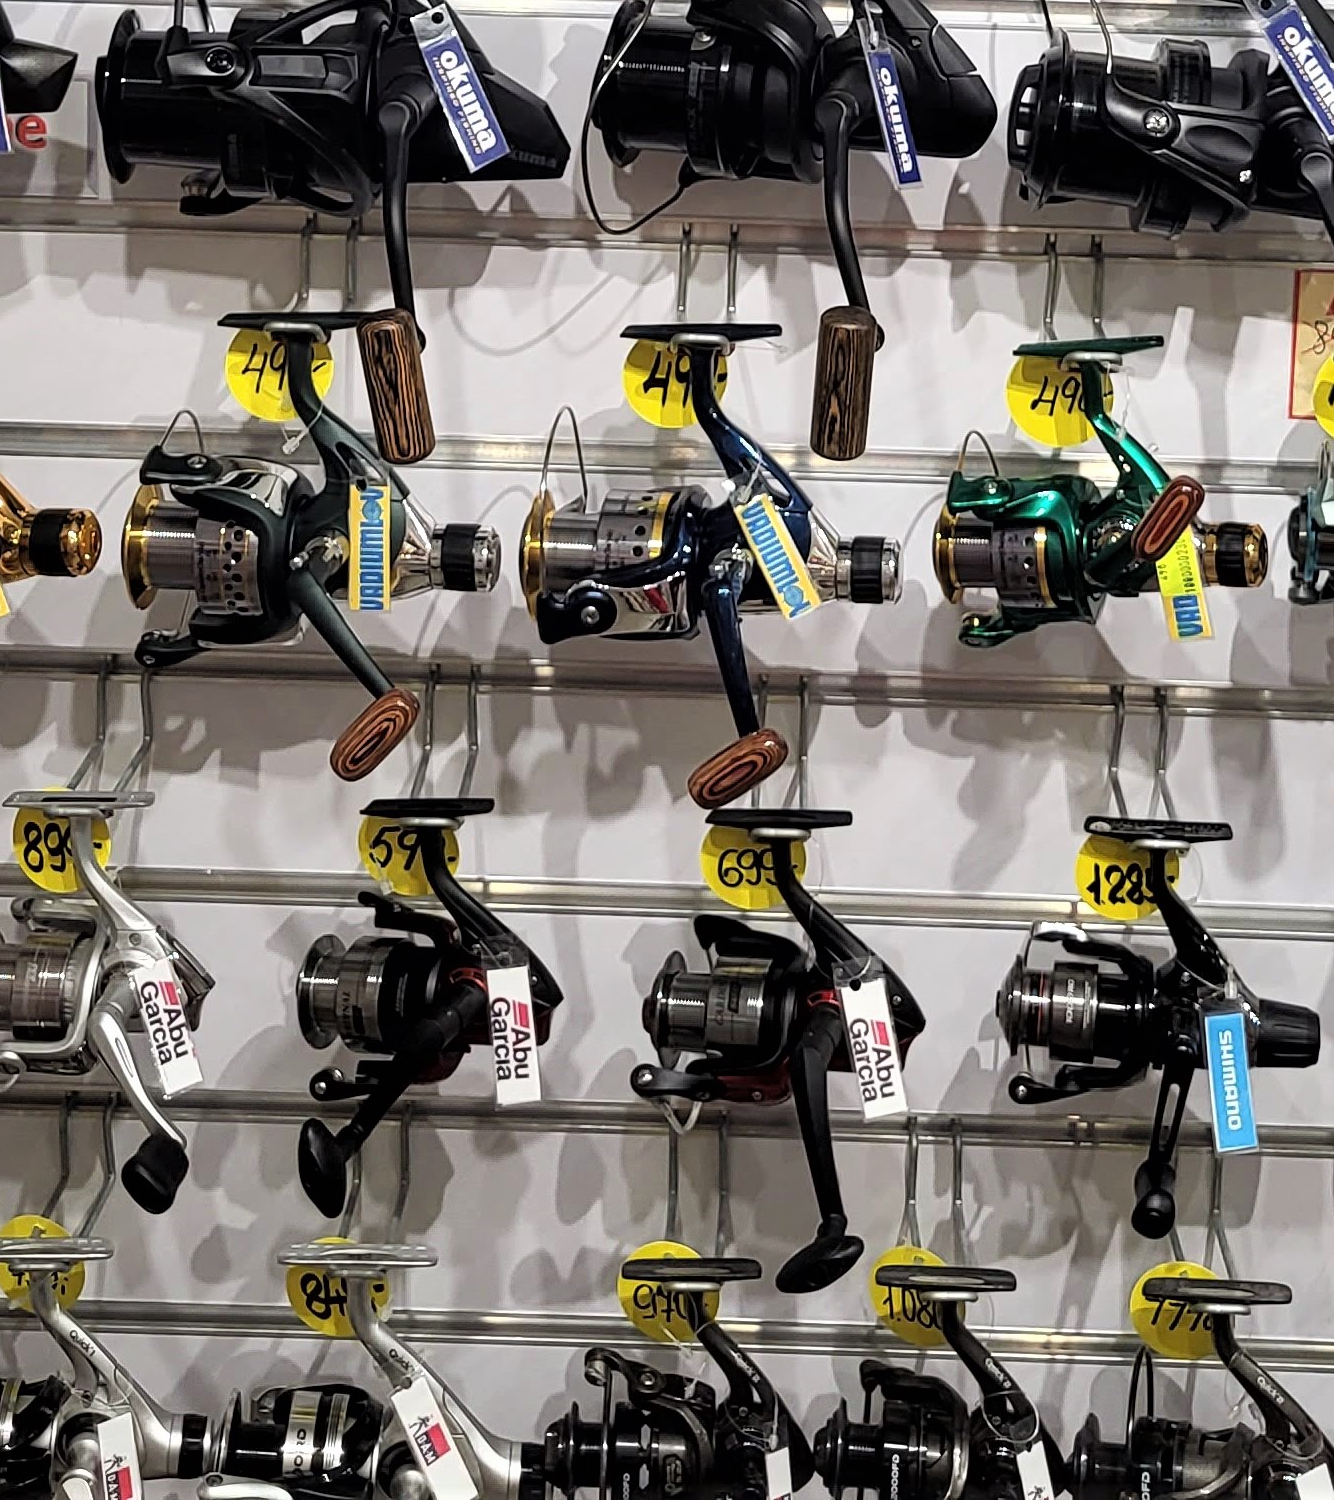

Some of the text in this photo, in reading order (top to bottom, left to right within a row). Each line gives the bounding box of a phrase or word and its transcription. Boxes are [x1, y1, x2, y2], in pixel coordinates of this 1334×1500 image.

[439, 50, 499, 154] okuma
[879, 66, 915, 174] okuma
[140, 980, 173, 1066] Garcia
[163, 1008, 189, 1059] Abu
[491, 996, 512, 1081] Garcia
[511, 1027, 530, 1079] Abu
[849, 1018, 878, 1103] Garcia
[872, 1046, 896, 1099] Abu
[1218, 1029, 1243, 1131] SHIMANO
